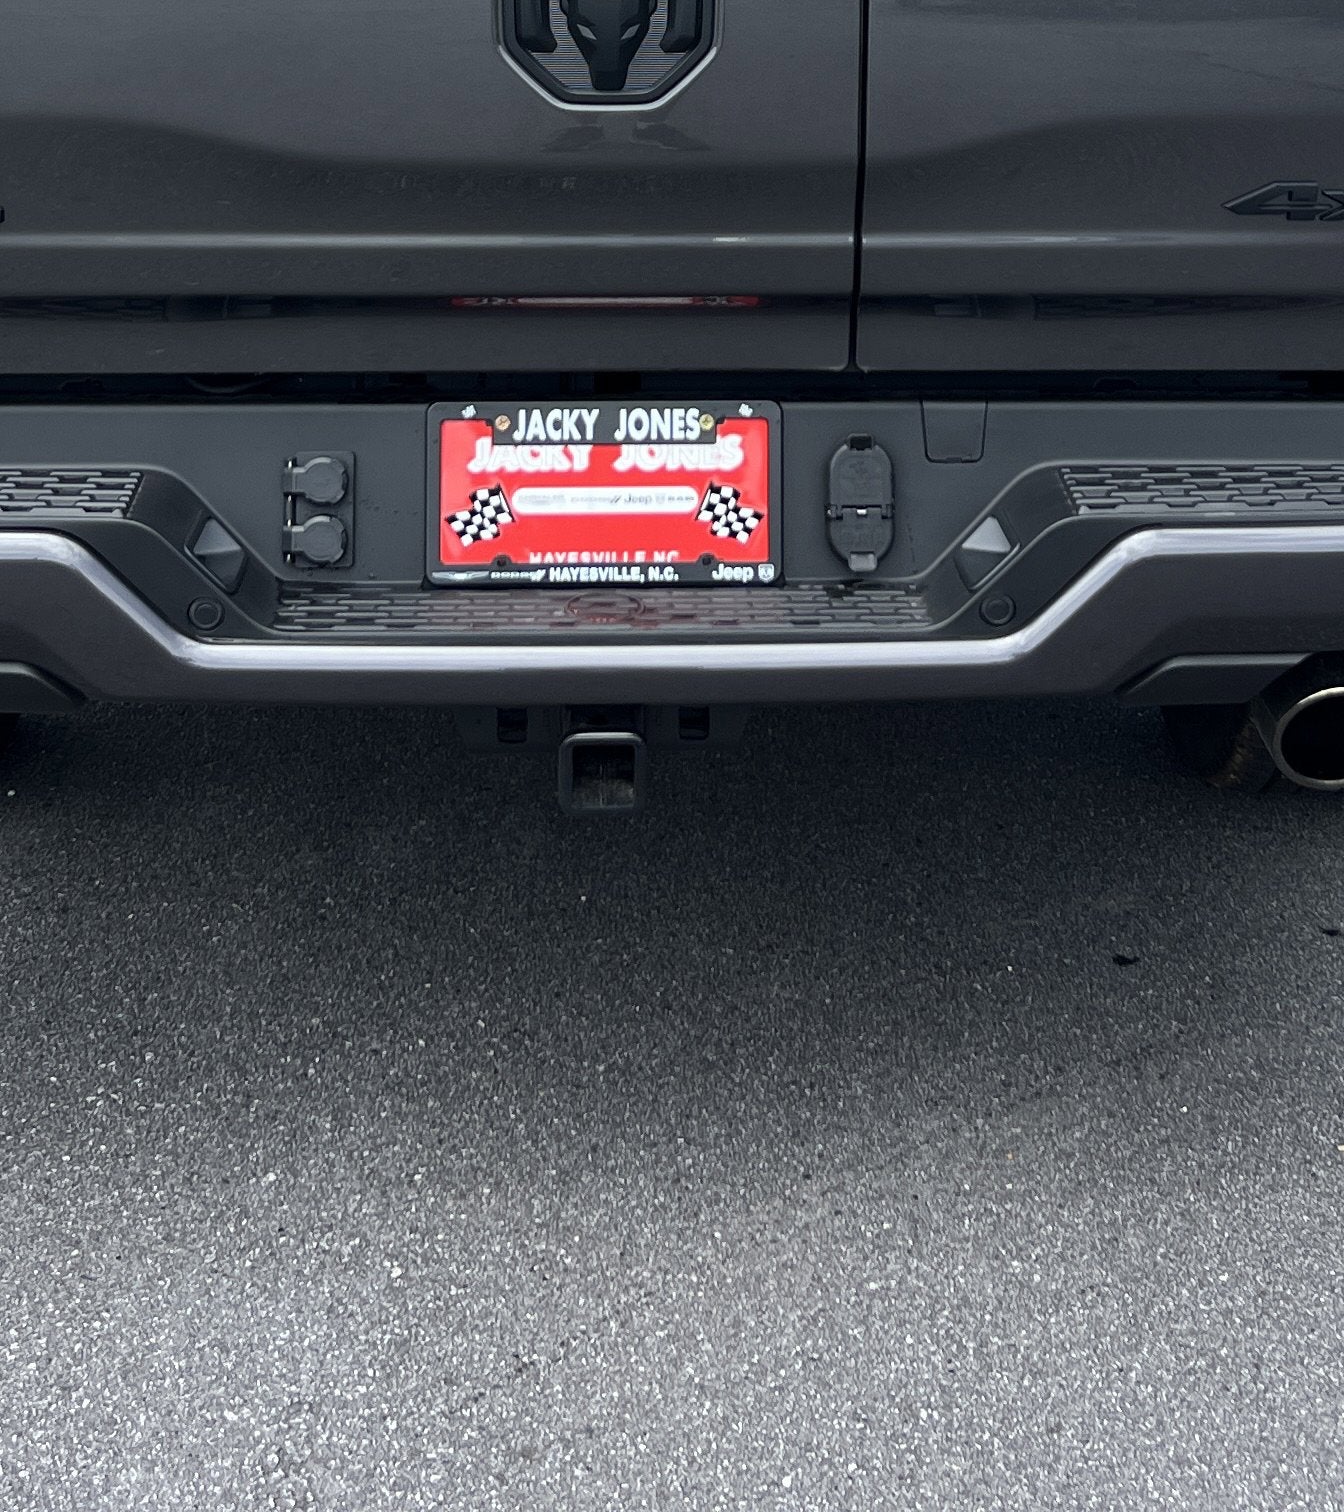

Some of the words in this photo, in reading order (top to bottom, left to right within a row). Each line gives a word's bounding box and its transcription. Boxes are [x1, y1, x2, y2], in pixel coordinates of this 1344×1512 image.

[513, 408, 600, 441] JACKY
[614, 407, 701, 441] JONES
[467, 436, 594, 473] JACKY
[611, 433, 745, 472] JONES
[549, 566, 645, 583] HAYESVILLE,
[648, 566, 679, 582] N.C.
[712, 563, 754, 583] Jeep
